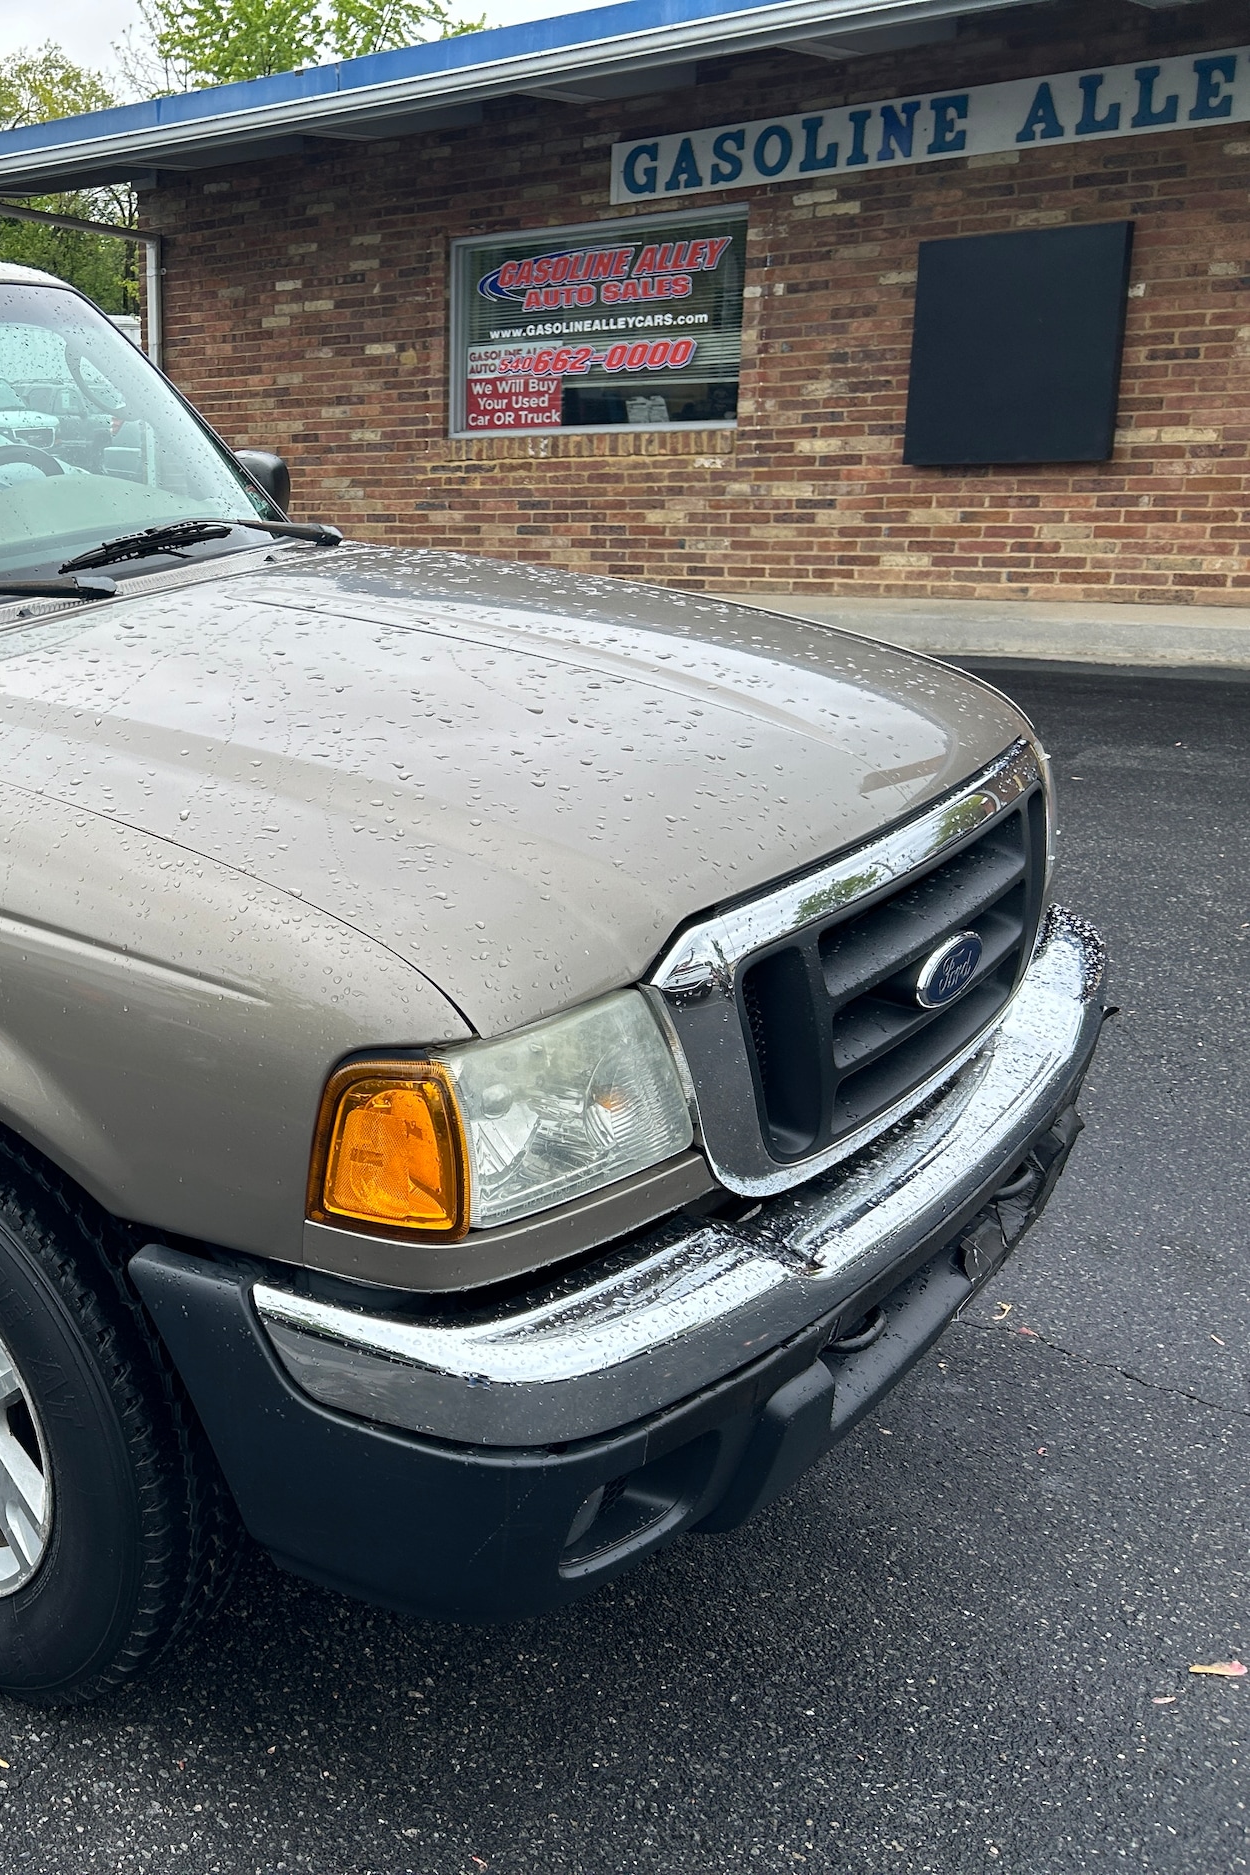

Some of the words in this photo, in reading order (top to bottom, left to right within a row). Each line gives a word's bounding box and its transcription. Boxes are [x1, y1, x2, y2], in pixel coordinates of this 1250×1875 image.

[622, 93, 969, 195] GASOLINE
[1015, 54, 1250, 143] ALLE
[496, 247, 635, 289] GASOLINE
[631, 235, 733, 278] ALLEY
[522, 283, 597, 312] AUTO
[601, 274, 692, 305] SALES
[489, 313, 709, 339] www.GASOLINEALLEYCARS.com
[469, 363, 497, 375] AUTO
[531, 336, 698, 377] 662-0000
[471, 382, 492, 395] We
[496, 379, 524, 394] Will
[528, 379, 558, 393] Buy
[478, 397, 508, 410] Your
[511, 394, 549, 408] Used
[468, 413, 490, 426] Car
[493, 411, 515, 425] OR
[518, 409, 561, 424] Truck
[938, 947, 972, 996] Ford
